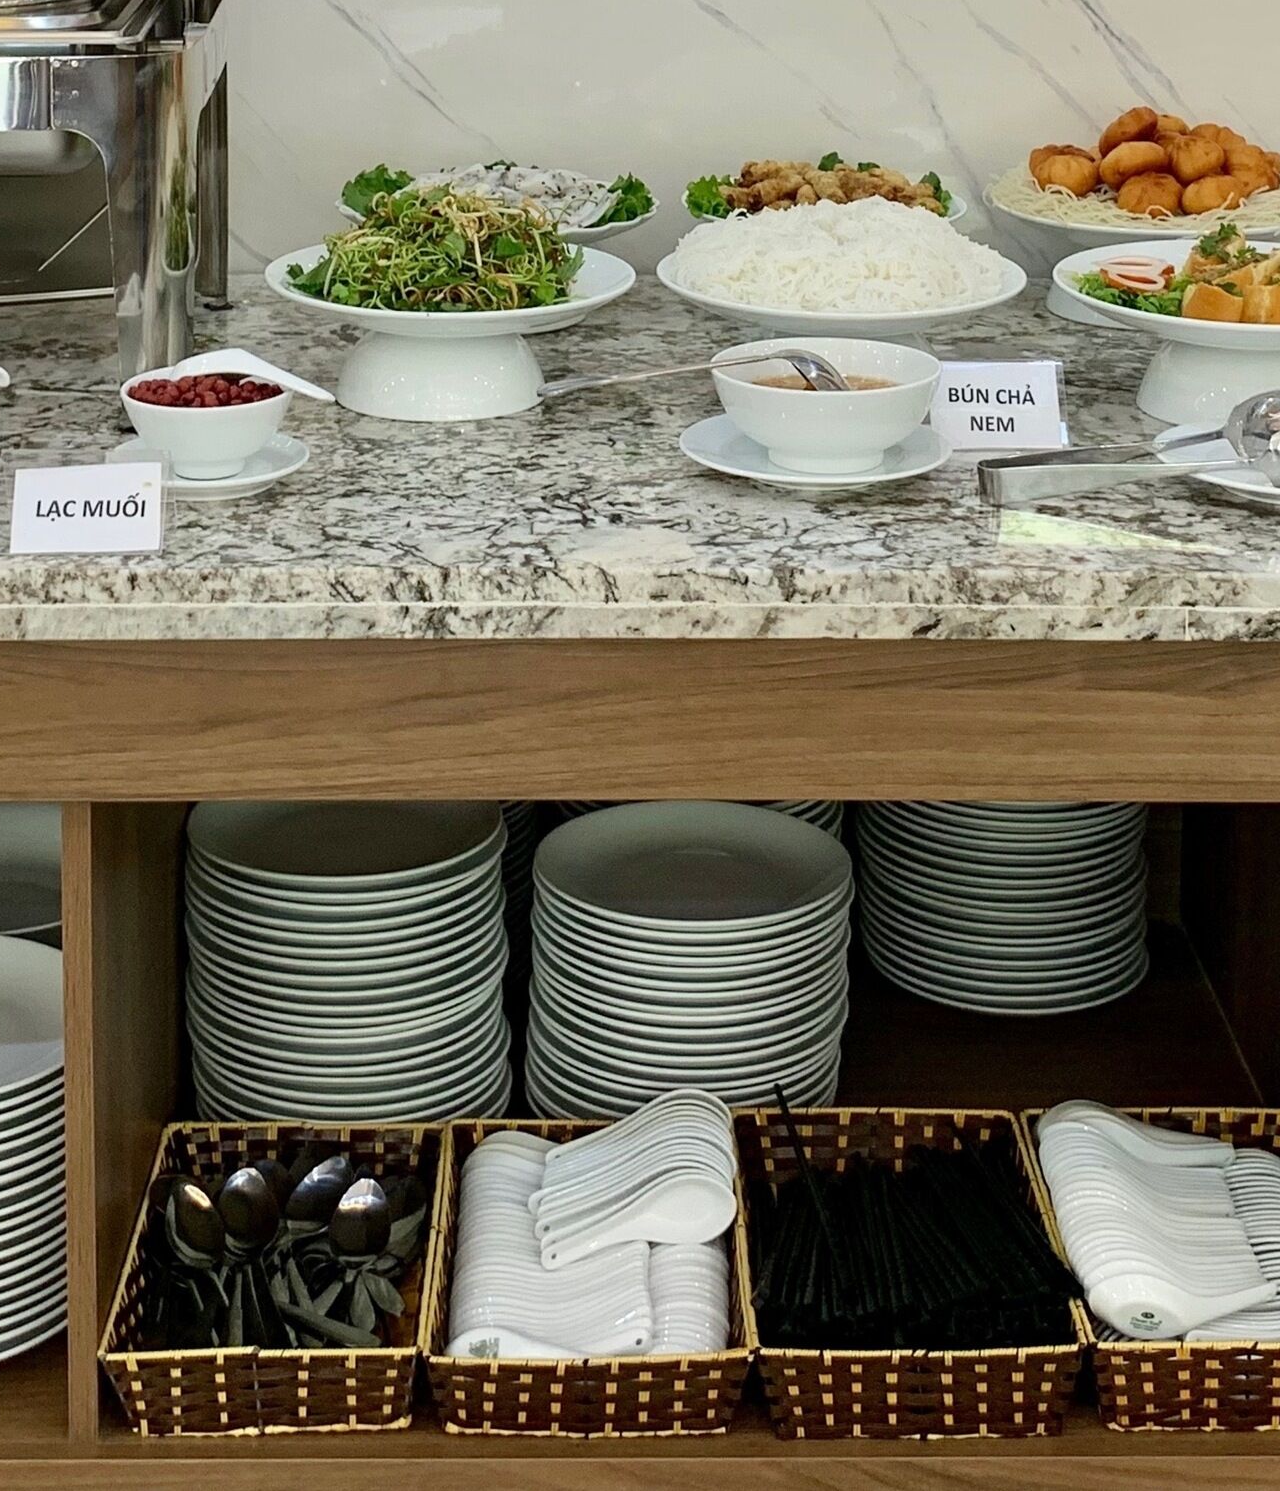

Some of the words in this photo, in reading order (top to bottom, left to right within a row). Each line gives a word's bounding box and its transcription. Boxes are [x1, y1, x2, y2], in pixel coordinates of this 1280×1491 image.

[948, 383, 989, 404] BÚN
[995, 384, 1036, 405] CHẢ
[970, 415, 1015, 433] NEM
[35, 499, 77, 522] LẠC
[82, 492, 147, 518] MUỐI
